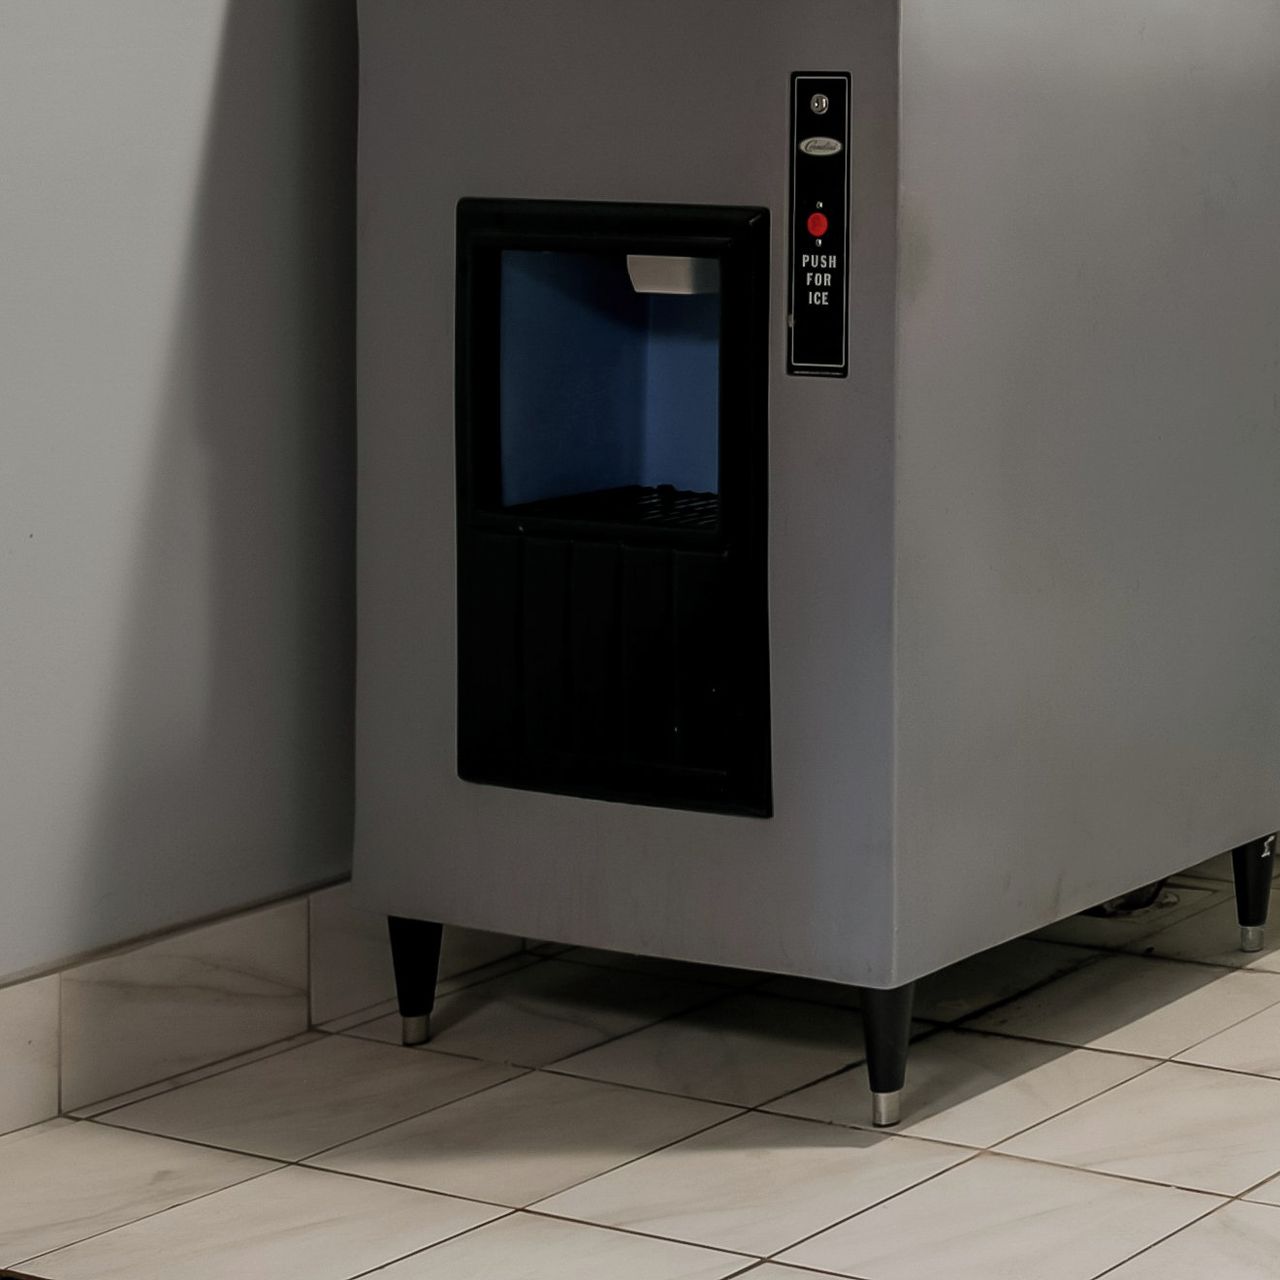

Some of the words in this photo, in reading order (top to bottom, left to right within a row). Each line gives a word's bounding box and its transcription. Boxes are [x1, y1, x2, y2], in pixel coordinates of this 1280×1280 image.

[802, 254, 837, 269] PUSH
[806, 273, 831, 287] FOR
[808, 292, 829, 306] ICE
